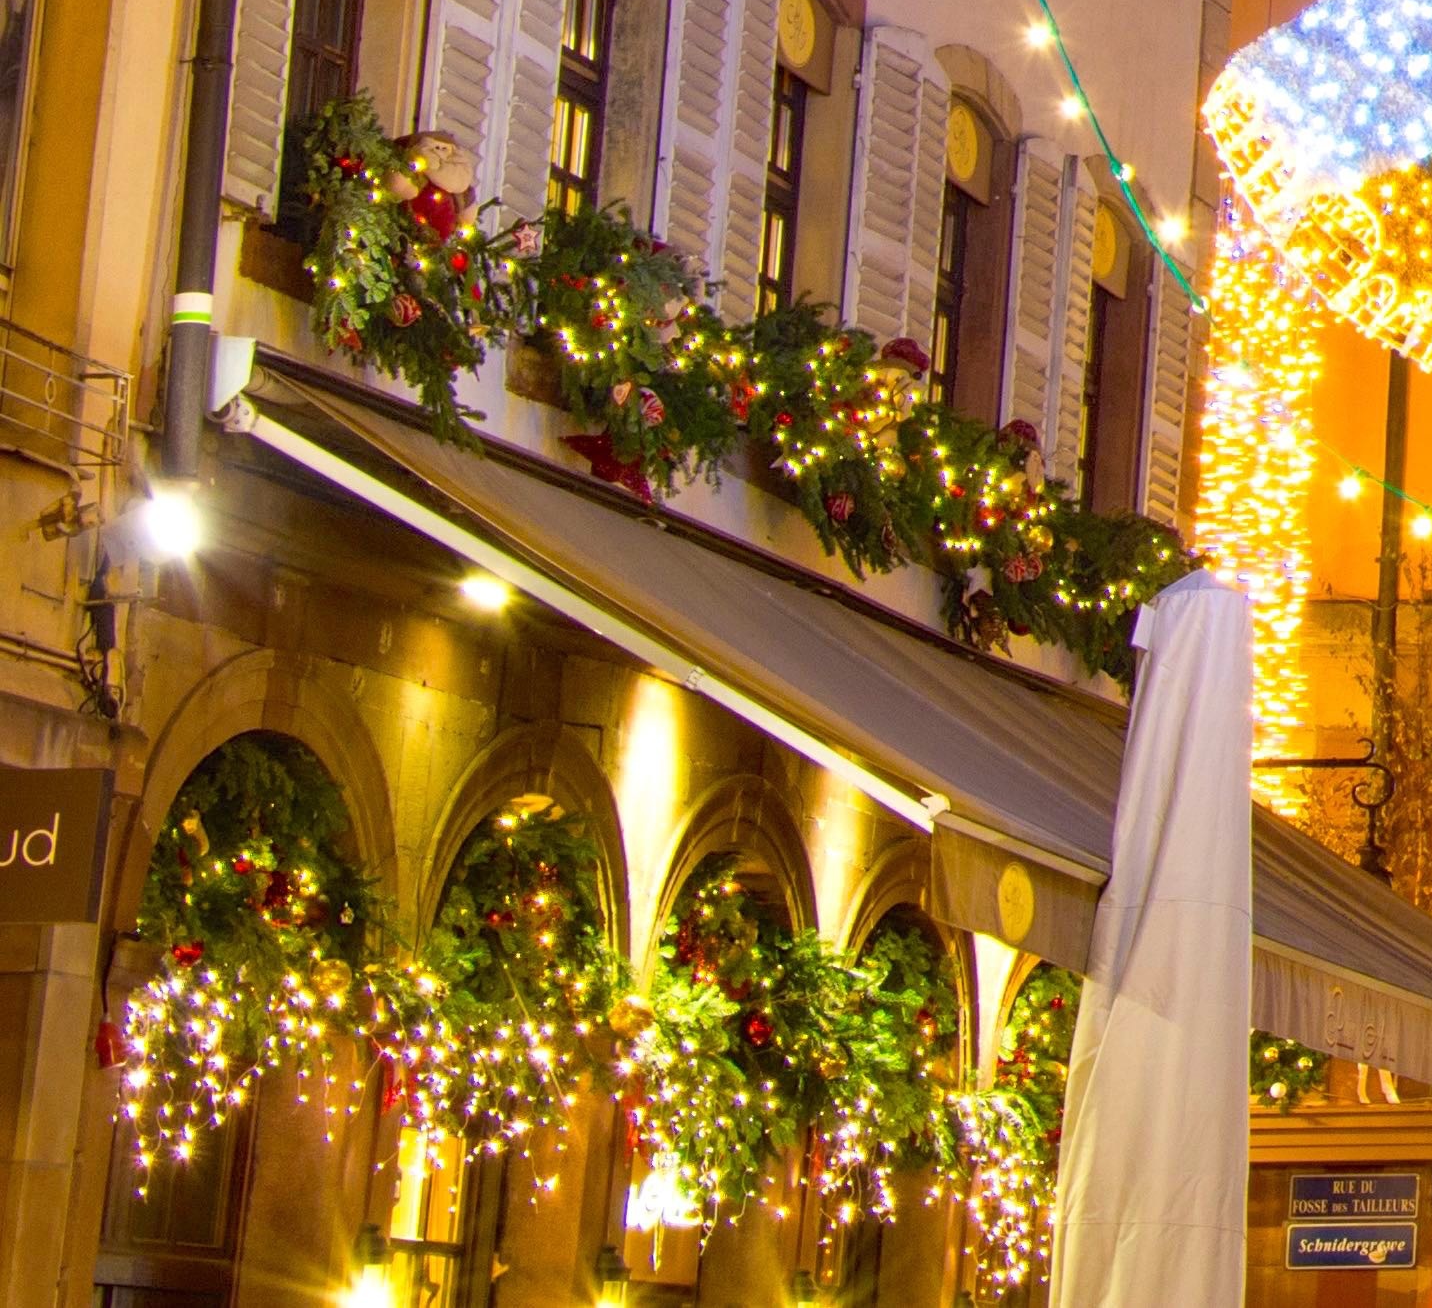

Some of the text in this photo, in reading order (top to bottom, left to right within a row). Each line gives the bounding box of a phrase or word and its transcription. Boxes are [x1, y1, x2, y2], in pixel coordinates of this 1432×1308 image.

[1332, 1179, 1378, 1194] RUE DU
[1292, 1199, 1329, 1214] FOSSE
[1352, 1198, 1416, 1213] TAILLEURS
